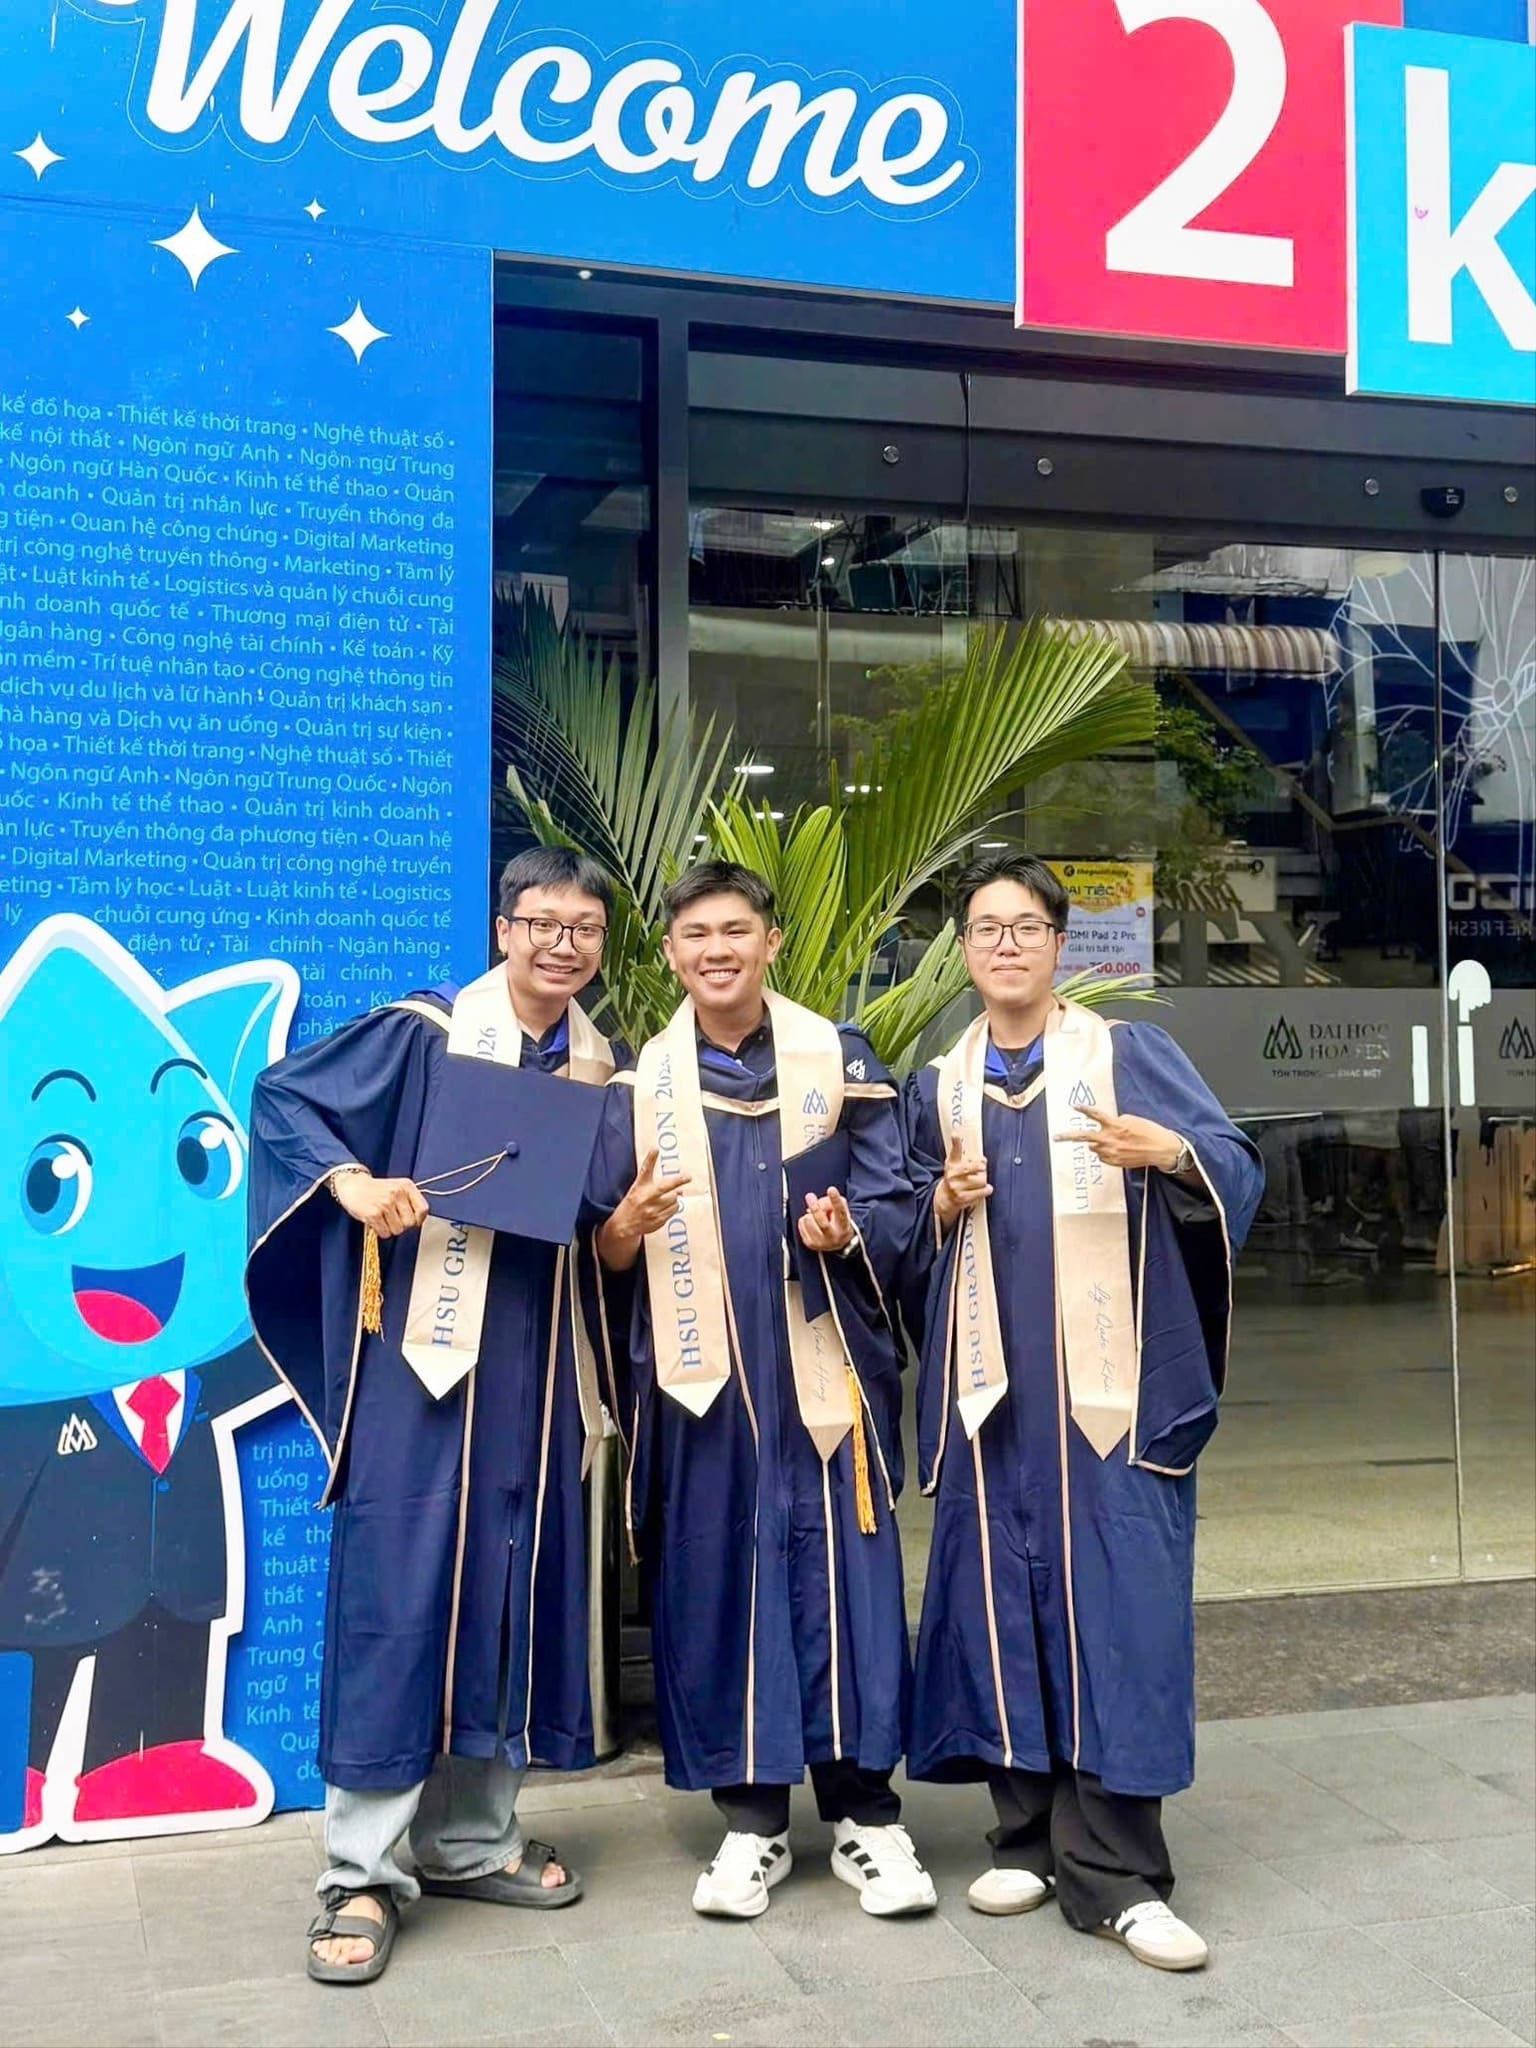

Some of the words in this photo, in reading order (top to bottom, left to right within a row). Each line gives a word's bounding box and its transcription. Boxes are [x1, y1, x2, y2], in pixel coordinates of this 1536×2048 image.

[86, 0, 964, 206] Welcome
[2, 393, 26, 414] kế
[30, 396, 58, 417] đồ
[63, 399, 102, 423] họa
[116, 403, 169, 426] Thiết
[173, 408, 197, 429] kế
[200, 411, 240, 432] thời
[245, 416, 297, 441] trang
[313, 421, 365, 446] Nghệ
[368, 426, 419, 450] thuật
[423, 430, 445, 450] số
[30, 426, 63, 448] nội
[69, 428, 112, 449] thất
[132, 433, 187, 457] Ngôn
[240, 442, 280, 464] Anh
[300, 447, 352, 471] Ngôn
[400, 455, 455, 481] Trung
[13, 479, 80, 502] doanh
[101, 486, 156, 508] Quản
[163, 492, 185, 514] trị
[192, 493, 242, 514] nhân
[250, 496, 279, 520] lực
[367, 506, 425, 532] thông
[431, 511, 455, 530] đa
[13, 508, 54, 531] tiện
[70, 511, 126, 533] Quan
[131, 515, 157, 539] hệ
[161, 519, 211, 544] công
[215, 522, 278, 549] chúng
[294, 527, 355, 552] Digital
[360, 532, 455, 561] Marketing
[32, 564, 78, 589] Luật
[81, 567, 125, 589] kinh
[129, 569, 151, 590] tế
[164, 573, 249, 598] Logistics
[252, 579, 275, 598] và
[278, 582, 328, 604] quản
[332, 583, 349, 607] lý
[407, 593, 454, 614] cung
[50, 621, 103, 647] hàng
[122, 626, 176, 652] Công
[183, 629, 234, 654] nghệ
[239, 633, 264, 652] tài
[269, 634, 324, 656] chính
[342, 638, 366, 657] Kế
[371, 641, 414, 659] toán
[432, 643, 455, 666] Kỹ
[48, 682, 75, 701] vụ
[79, 679, 107, 699] du
[111, 680, 147, 704] lịch
[151, 683, 175, 702] và
[203, 685, 253, 706] hành
[268, 689, 321, 709] Quản
[325, 692, 346, 714] trị
[351, 692, 407, 713] khách
[411, 699, 443, 718] sạn
[8, 732, 49, 756] họa
[62, 734, 115, 755] Thiết
[119, 735, 144, 756] kế
[147, 737, 187, 758] thời
[191, 741, 245, 765] trang
[260, 742, 313, 767] Nghệ
[316, 744, 368, 769] thuật
[371, 746, 393, 766] số
[405, 748, 454, 769] Thiết
[57, 791, 103, 811] Kinh
[111, 790, 132, 812] tế
[178, 794, 225, 814] thao
[244, 797, 298, 817] Quản
[303, 799, 325, 821] trị
[332, 799, 373, 819] kinh
[379, 801, 440, 821] doanh
[11, 846, 79, 870] Digital
[84, 847, 187, 873] Marketing
[202, 850, 256, 871] Quản
[260, 852, 281, 875] trị
[286, 853, 334, 877] công
[338, 854, 388, 877] nghệ
[4, 902, 23, 927] lý
[155, 909, 206, 929] cung
[211, 906, 250, 930] ứng
[266, 907, 311, 926] Kinh
[314, 908, 376, 928] doanh
[380, 908, 429, 932] quốc
[433, 908, 452, 928] tế
[127, 932, 172, 956] điện
[220, 934, 249, 953] Tài
[268, 934, 323, 954] chính
[338, 936, 389, 959] Ngân
[393, 935, 441, 959] hàng
[1111, 930, 1119, 940] 2
[951, 1080, 963, 1130] 2026
[655, 1111, 695, 1299] GRADTION
[443, 1221, 469, 1277] GRA
[431, 1285, 461, 1348] HSU
[676, 1307, 702, 1369] HSU
[968, 1330, 988, 1391] HSU
[253, 1440, 274, 1465] trị
[278, 1440, 315, 1460] nhà
[257, 1467, 309, 1492] uống
[261, 1499, 312, 1518] Thiết
[263, 1525, 286, 1547] kế
[263, 1555, 317, 1577] thuật
[263, 1583, 304, 1605] thất
[262, 1616, 303, 1635] Anh
[248, 1645, 306, 1667] Trung
[246, 1673, 288, 1698] ngữ
[246, 1704, 292, 1725] Kinh
